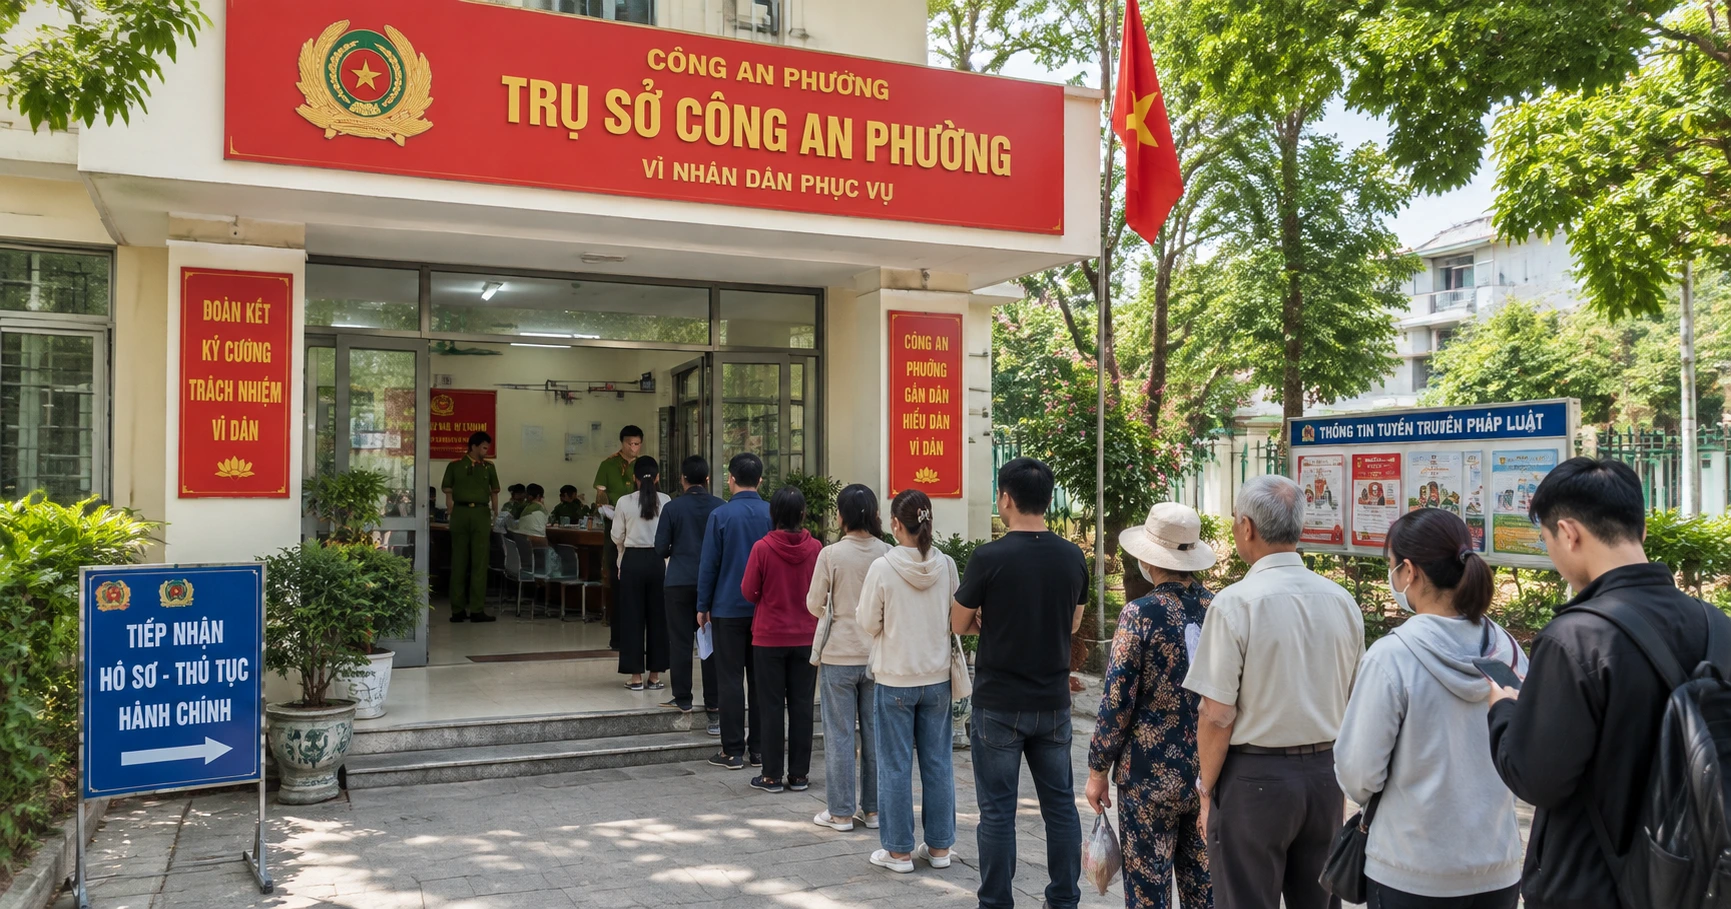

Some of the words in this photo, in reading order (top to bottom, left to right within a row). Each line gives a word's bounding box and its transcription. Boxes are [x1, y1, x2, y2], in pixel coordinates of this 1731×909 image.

[647, 47, 727, 79] CÔNG
[736, 61, 773, 85] AN
[502, 75, 588, 139] TRỤ
[605, 79, 662, 137] SỞ
[677, 91, 787, 152] CÔNG
[800, 113, 852, 159] AN
[867, 120, 1011, 176] PHƯỜNG
[674, 161, 736, 186] NHÂN
[746, 167, 792, 191] DÂN
[801, 175, 858, 200] PHỤC
[866, 182, 893, 205] VỤ
[245, 297, 271, 324] KẾT
[935, 335, 949, 350] AN
[1356, 423, 1374, 437] TIN
[126, 616, 167, 648] TIẾP
[173, 615, 224, 649] NHẬN
[131, 661, 159, 689] SƠ
[215, 657, 249, 687] TỤC
[176, 695, 232, 725] CHÍNH
